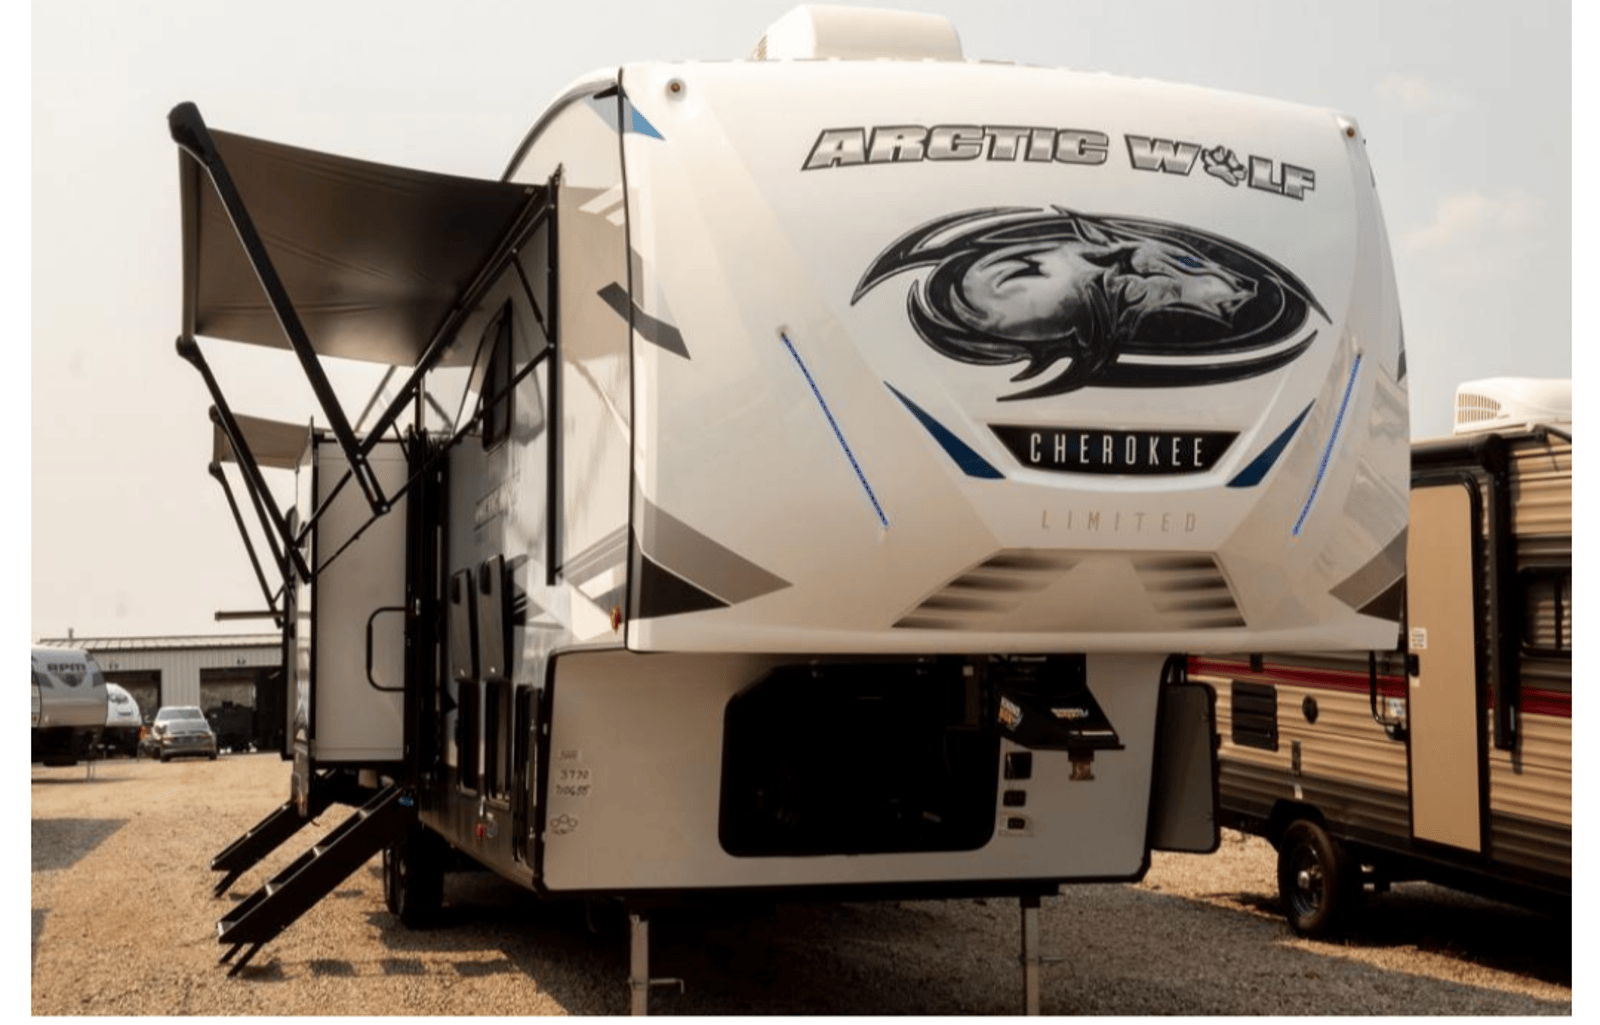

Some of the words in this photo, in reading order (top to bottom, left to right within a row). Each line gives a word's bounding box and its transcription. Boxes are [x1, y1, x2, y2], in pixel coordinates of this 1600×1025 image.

[801, 124, 1109, 171] ARCTIC
[1029, 432, 1206, 469] CHEROKEE
[1041, 509, 1197, 533] LIMITED
